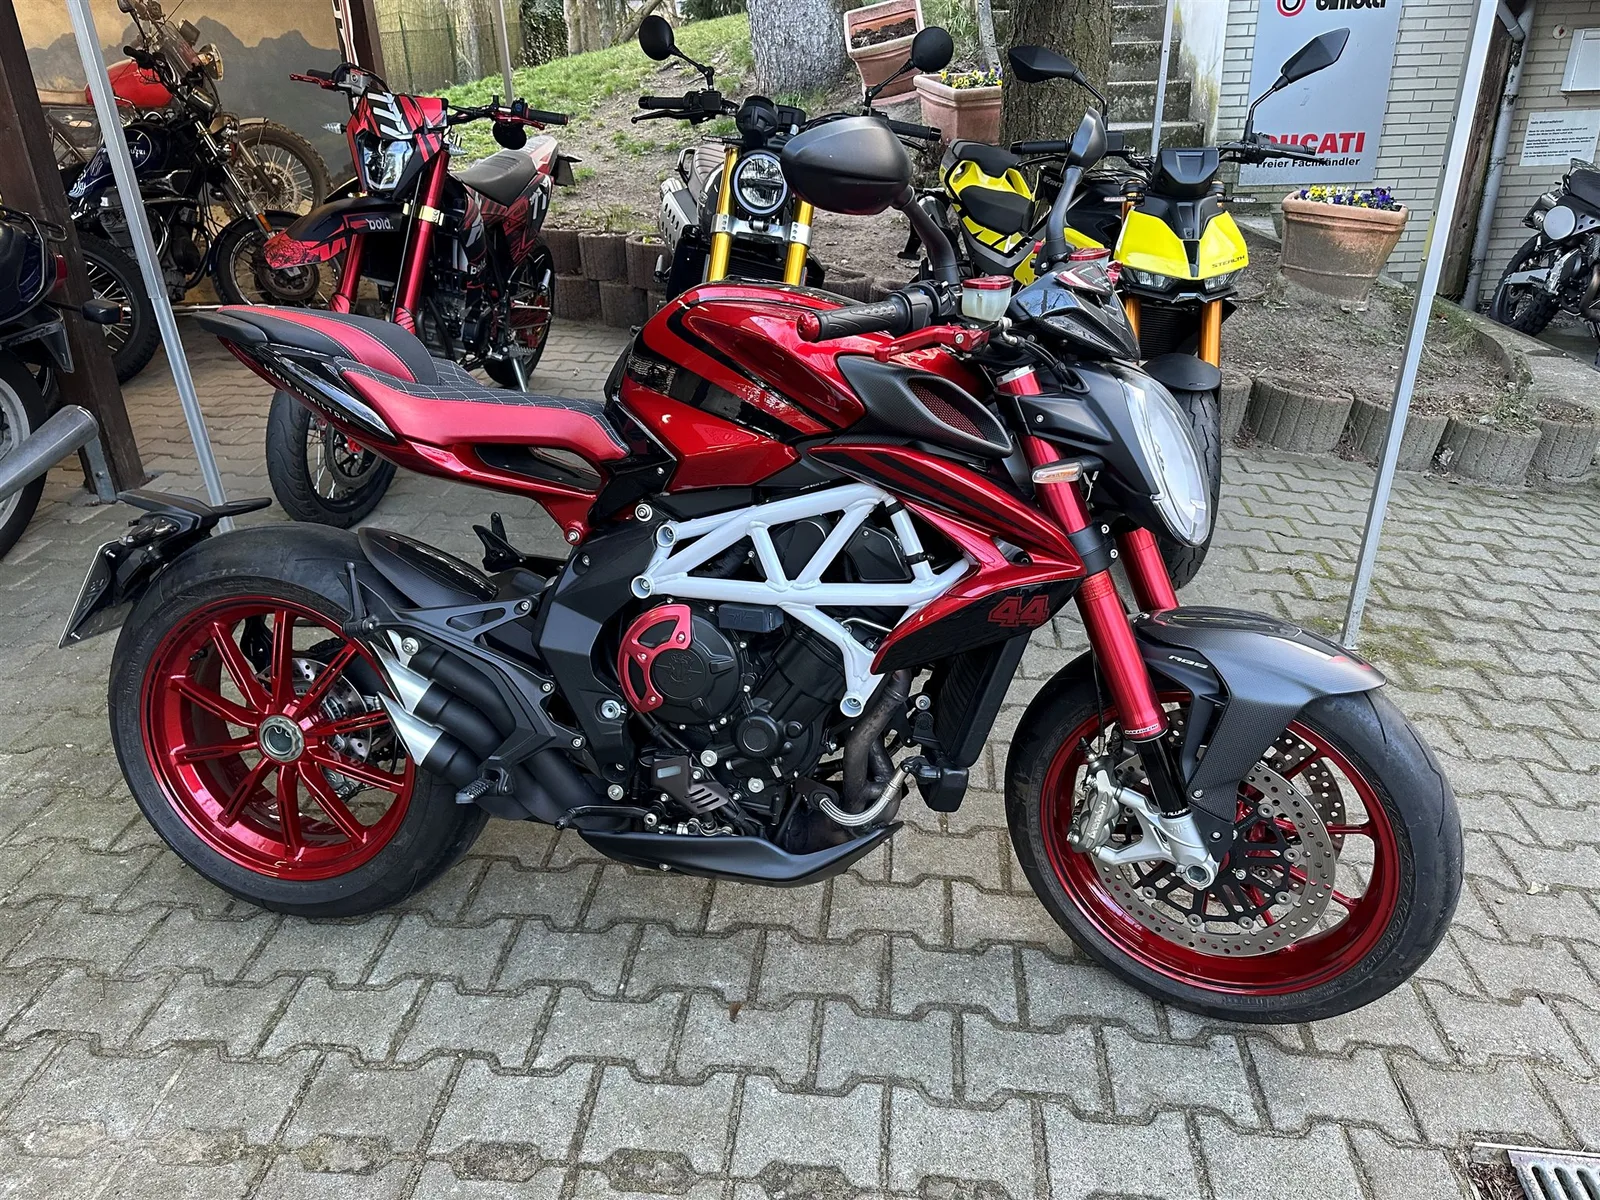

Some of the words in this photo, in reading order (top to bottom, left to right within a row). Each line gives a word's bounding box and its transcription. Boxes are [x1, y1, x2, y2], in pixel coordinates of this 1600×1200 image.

[1268, 131, 1366, 154] UCATI
[1291, 157, 1361, 168] Fachändler
[1211, 255, 1245, 268] STEALTH
[263, 363, 292, 387] LEWIS
[295, 386, 349, 423] HAMILTON
[987, 594, 1050, 628] 44
